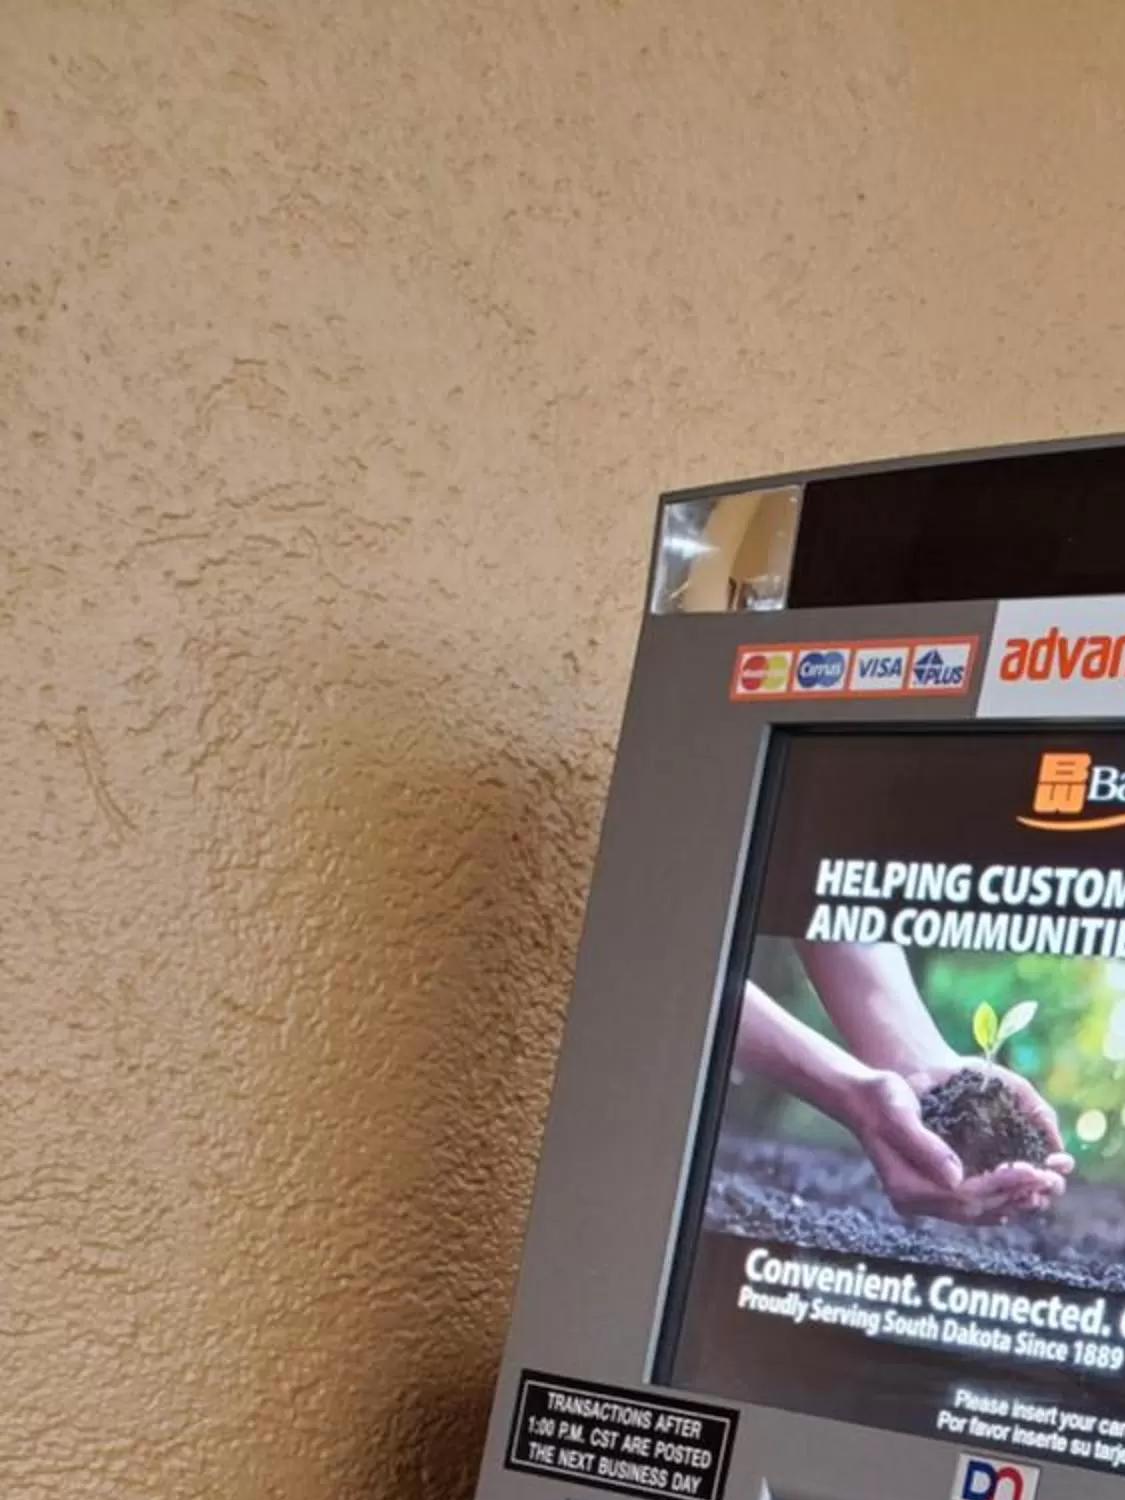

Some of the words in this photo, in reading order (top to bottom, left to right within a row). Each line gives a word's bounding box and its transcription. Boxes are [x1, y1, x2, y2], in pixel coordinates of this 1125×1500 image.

[800, 660, 842, 678] Cirrus
[858, 657, 902, 678] VISA
[922, 665, 965, 685] PLUS
[814, 858, 973, 902] HELPING
[805, 903, 886, 942] AND
[744, 1247, 922, 1307] Convenient.
[929, 1275, 1110, 1337] Connected.
[737, 1284, 809, 1324] Proudly
[809, 1298, 881, 1336] Serving
[882, 1310, 939, 1341] South
[941, 1319, 1013, 1352] Dakota
[1013, 1329, 1069, 1363] Since
[1072, 1339, 1125, 1371] 1889
[547, 1391, 653, 1431] TRANSACTIONS
[653, 1415, 703, 1440] AFTER
[936, 1408, 968, 1433] Por
[968, 1415, 1011, 1442] favor
[1011, 1426, 1068, 1453] inserte
[1069, 1439, 1092, 1457] su
[954, 1388, 1010, 1417] Please
[1010, 1399, 1058, 1425] insert
[1057, 1410, 1098, 1432] your
[527, 1415, 555, 1437] 1:00
[557, 1420, 585, 1443] P.M.
[589, 1427, 620, 1450] CST
[620, 1434, 652, 1458] ARE
[653, 1440, 713, 1470] POSTED
[527, 1441, 555, 1464] THE
[557, 1449, 596, 1472] NEXT
[597, 1455, 669, 1489] BUSINESS
[671, 1472, 702, 1495] DAY
